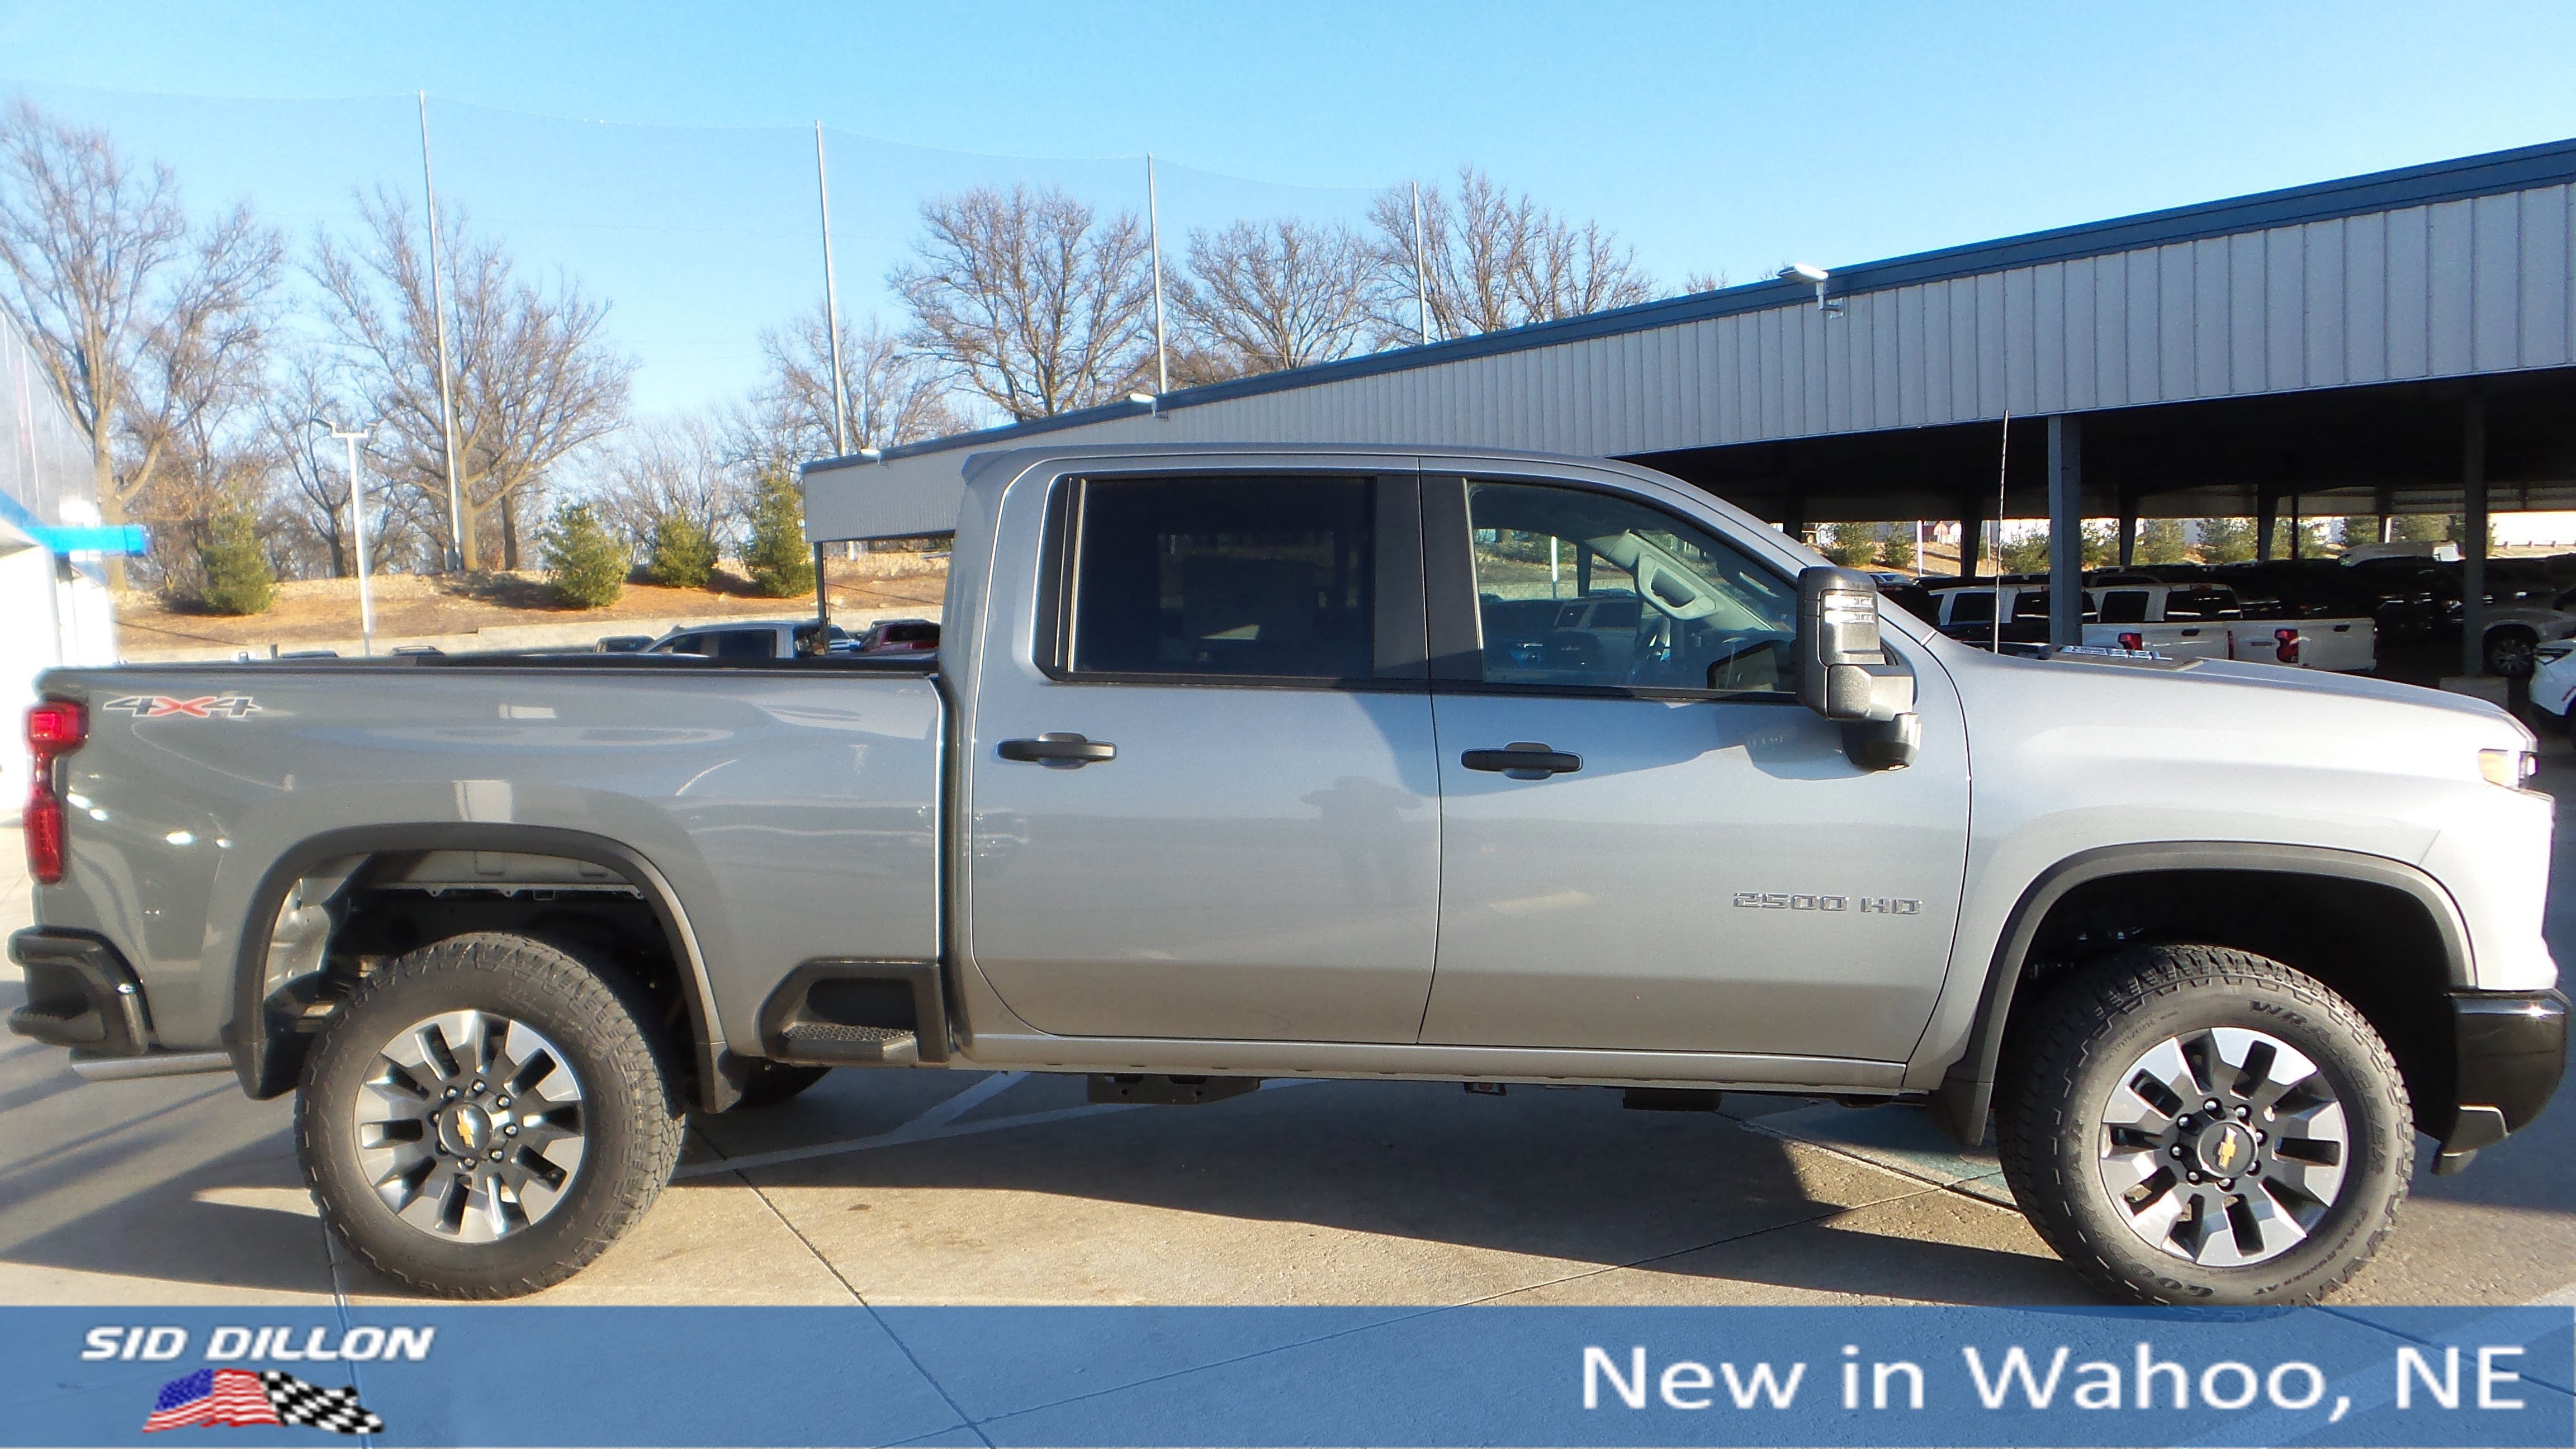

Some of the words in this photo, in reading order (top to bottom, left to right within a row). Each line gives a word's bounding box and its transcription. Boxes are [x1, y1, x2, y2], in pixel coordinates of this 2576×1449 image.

[1733, 892, 1848, 911] 2500
[1860, 897, 1922, 915] HD
[2250, 1000, 2387, 1174] WRANGLER
